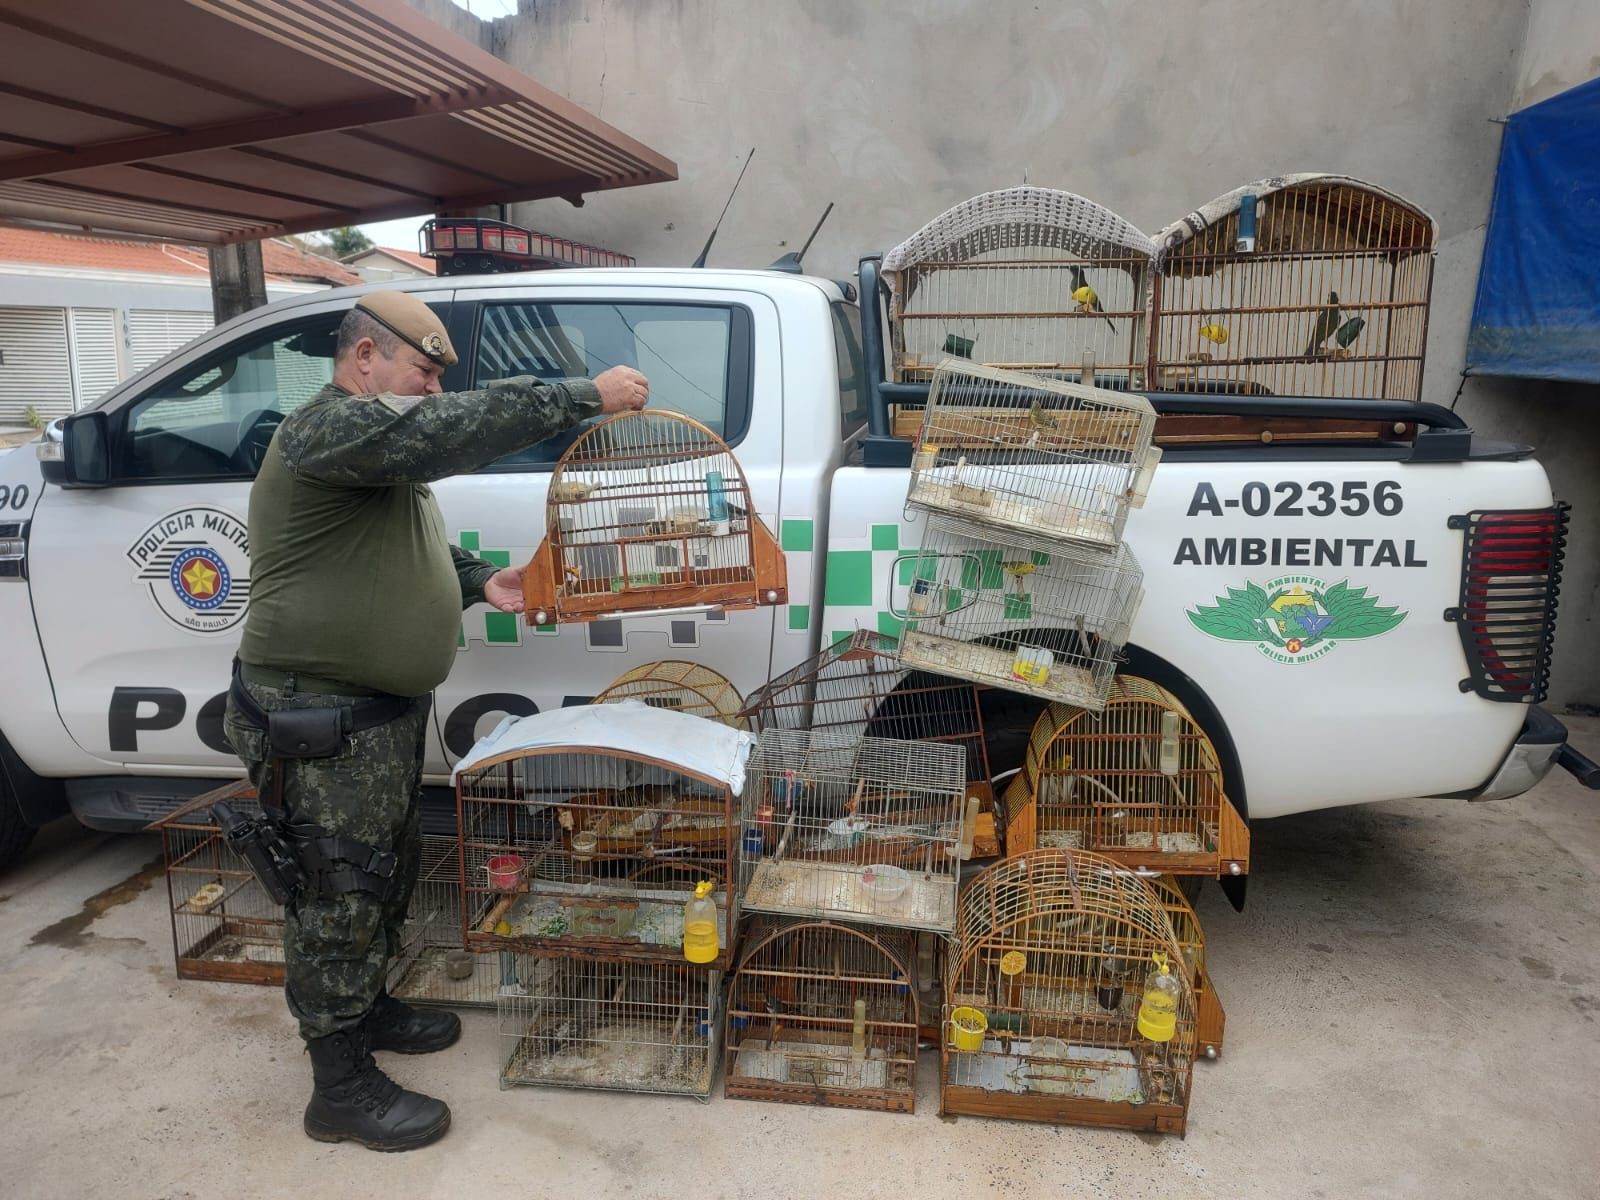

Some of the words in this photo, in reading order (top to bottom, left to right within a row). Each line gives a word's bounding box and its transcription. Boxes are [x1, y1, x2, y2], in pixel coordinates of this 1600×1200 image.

[1186, 480, 1404, 517] A-02356
[202, 513, 250, 557] MILITA
[1173, 537, 1428, 568] AMBIENTAL
[1267, 576, 1326, 590] AMBIENTAL
[202, 617, 229, 629] PAULO
[1296, 640, 1337, 663] MILITAR
